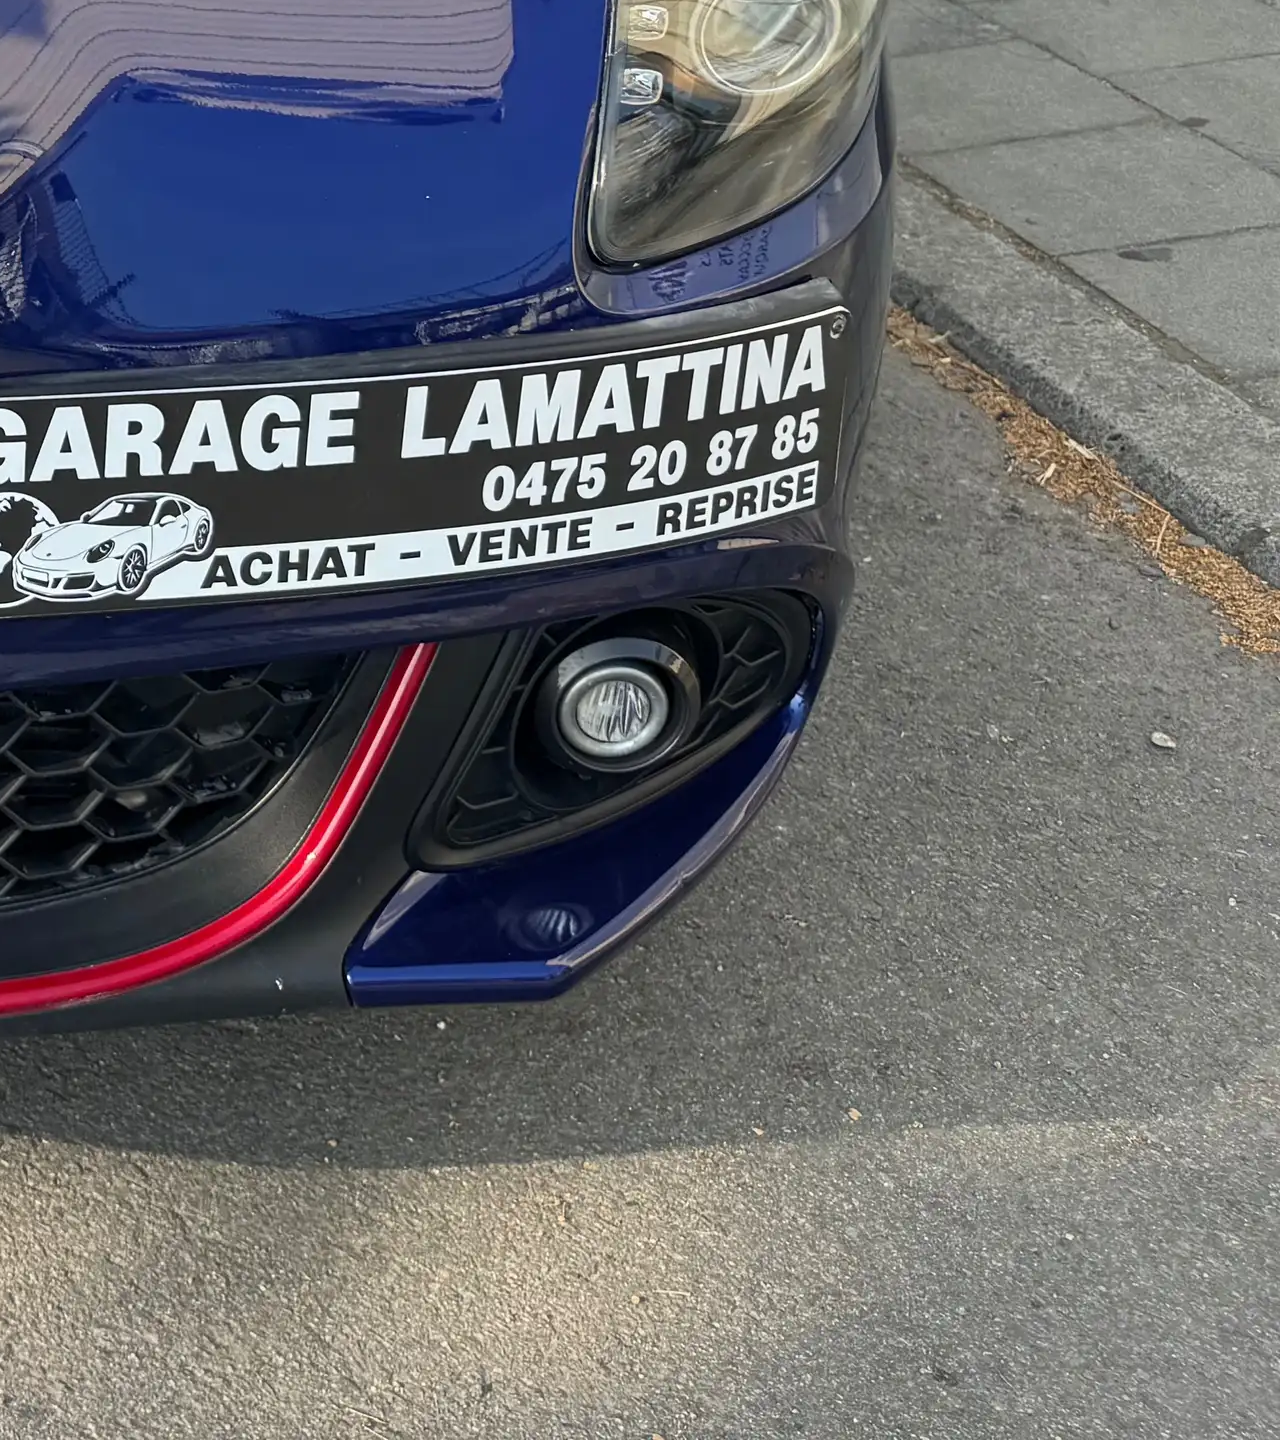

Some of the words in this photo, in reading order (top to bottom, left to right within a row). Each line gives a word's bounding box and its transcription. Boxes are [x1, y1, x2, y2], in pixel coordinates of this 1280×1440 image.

[400, 324, 826, 459] LAMATTINA
[482, 452, 608, 512] 0475
[626, 439, 688, 492] 20
[705, 423, 760, 477] 87
[771, 407, 820, 462] 85
[200, 542, 375, 589] ACHAT
[446, 515, 593, 568] VENTE
[656, 467, 817, 537] REPRISE
